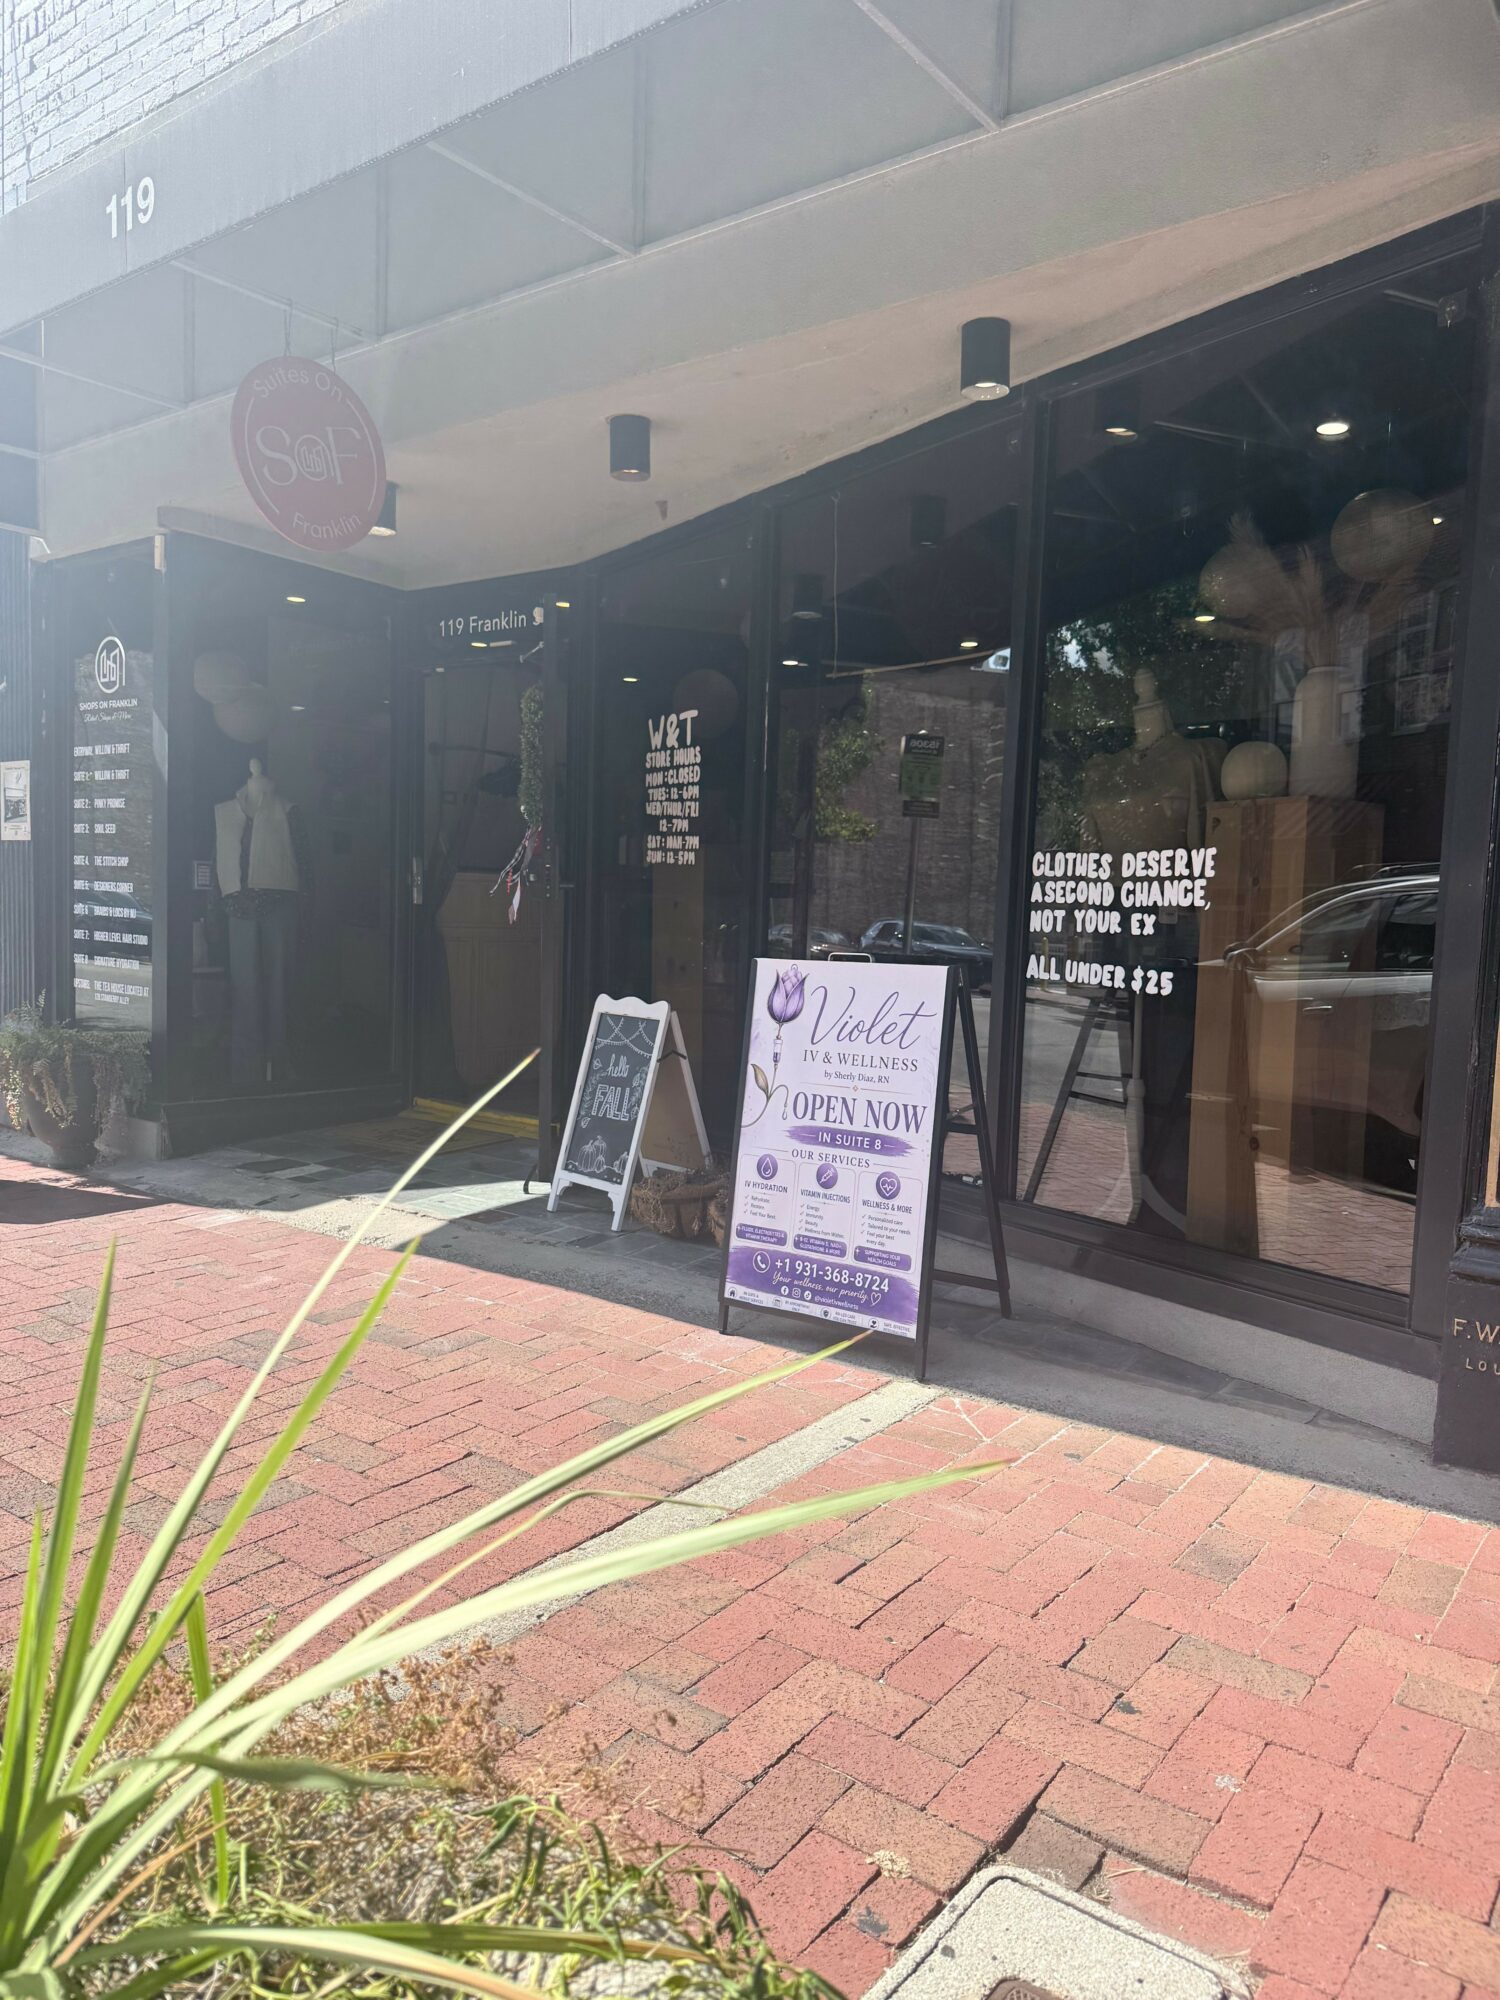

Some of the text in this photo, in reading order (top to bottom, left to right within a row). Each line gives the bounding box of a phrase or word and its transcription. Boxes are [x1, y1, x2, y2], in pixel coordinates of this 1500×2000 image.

[105, 176, 155, 239] 119
[253, 367, 345, 403] Suites On
[292, 512, 361, 538] Franklin
[439, 617, 465, 637] 119
[469, 610, 527, 634] Franklin
[79, 698, 138, 711] SHOPS ON FRANKLIN
[648, 709, 699, 751] W&T
[94, 744, 111, 755] WILLOW
[115, 742, 130, 754] THRIFT
[645, 745, 702, 769] STORE HOURS
[73, 771, 85, 781] SUITE
[94, 770, 111, 780] WILLOW
[115, 769, 130, 780] THRIFT
[648, 785, 700, 801] TUES: 12-6PM
[73, 798, 85, 808] SUITE
[94, 798, 106, 808] PINKY
[107, 798, 126, 808] PROMISE
[645, 801, 699, 818] WED/THUR/FRI
[73, 823, 85, 833] SUITE
[94, 823, 104, 833] SOUL
[105, 823, 116, 834] SEED
[659, 818, 689, 833] 12-7PM
[647, 835, 700, 849] SAT: 10AM-7PM
[73, 855, 129, 866] SUITE THE STITCH SHOP
[646, 850, 696, 866] SUN: 12-5PM
[1031, 846, 1217, 881] CLOTHES DESERVE
[73, 880, 84, 890] SUITE
[116, 882, 134, 893] CORNER
[1120, 878, 1211, 911] CHANCE,
[73, 904, 84, 915] SUITE
[112, 907, 123, 917] LOCS
[124, 908, 130, 918] BY
[1029, 909, 1157, 936] NOT YOUR EX
[73, 929, 84, 939] SUITE
[93, 930, 108, 941] HIGHER
[109, 931, 121, 943] LEVEL
[122, 933, 132, 944] HAIR
[133, 934, 148, 946] STUDIO
[73, 953, 140, 970] SUITE SIGNATURE HYDRATION
[1026, 954, 1175, 996] ALL UNDER $25
[94, 980, 103, 991] THE
[111, 982, 124, 993] HOUSE
[125, 984, 143, 997] LOCATED
[143, 986, 149, 998] AT
[810, 985, 938, 1050] Violet
[606, 1053, 630, 1078] hello
[803, 1049, 919, 1073] IV & WELLNESS
[824, 1069, 890, 1085] by Sherly Diaz, RN
[591, 1084, 631, 1122] FALL
[792, 1091, 928, 1135] OPEN NOW
[818, 1131, 882, 1151] IN SUITE 8
[792, 1148, 871, 1169] OUR SERVICES
[744, 1180, 789, 1194] IV HYDRATION
[800, 1188, 851, 1204] VITAMIN INJECTIONS
[862, 1199, 913, 1215] WELLNESS & MORE
[772, 1270, 792, 1285] Your
[825, 1285, 838, 1294] our
[775, 1258, 890, 1294] +1 931-368-8724
